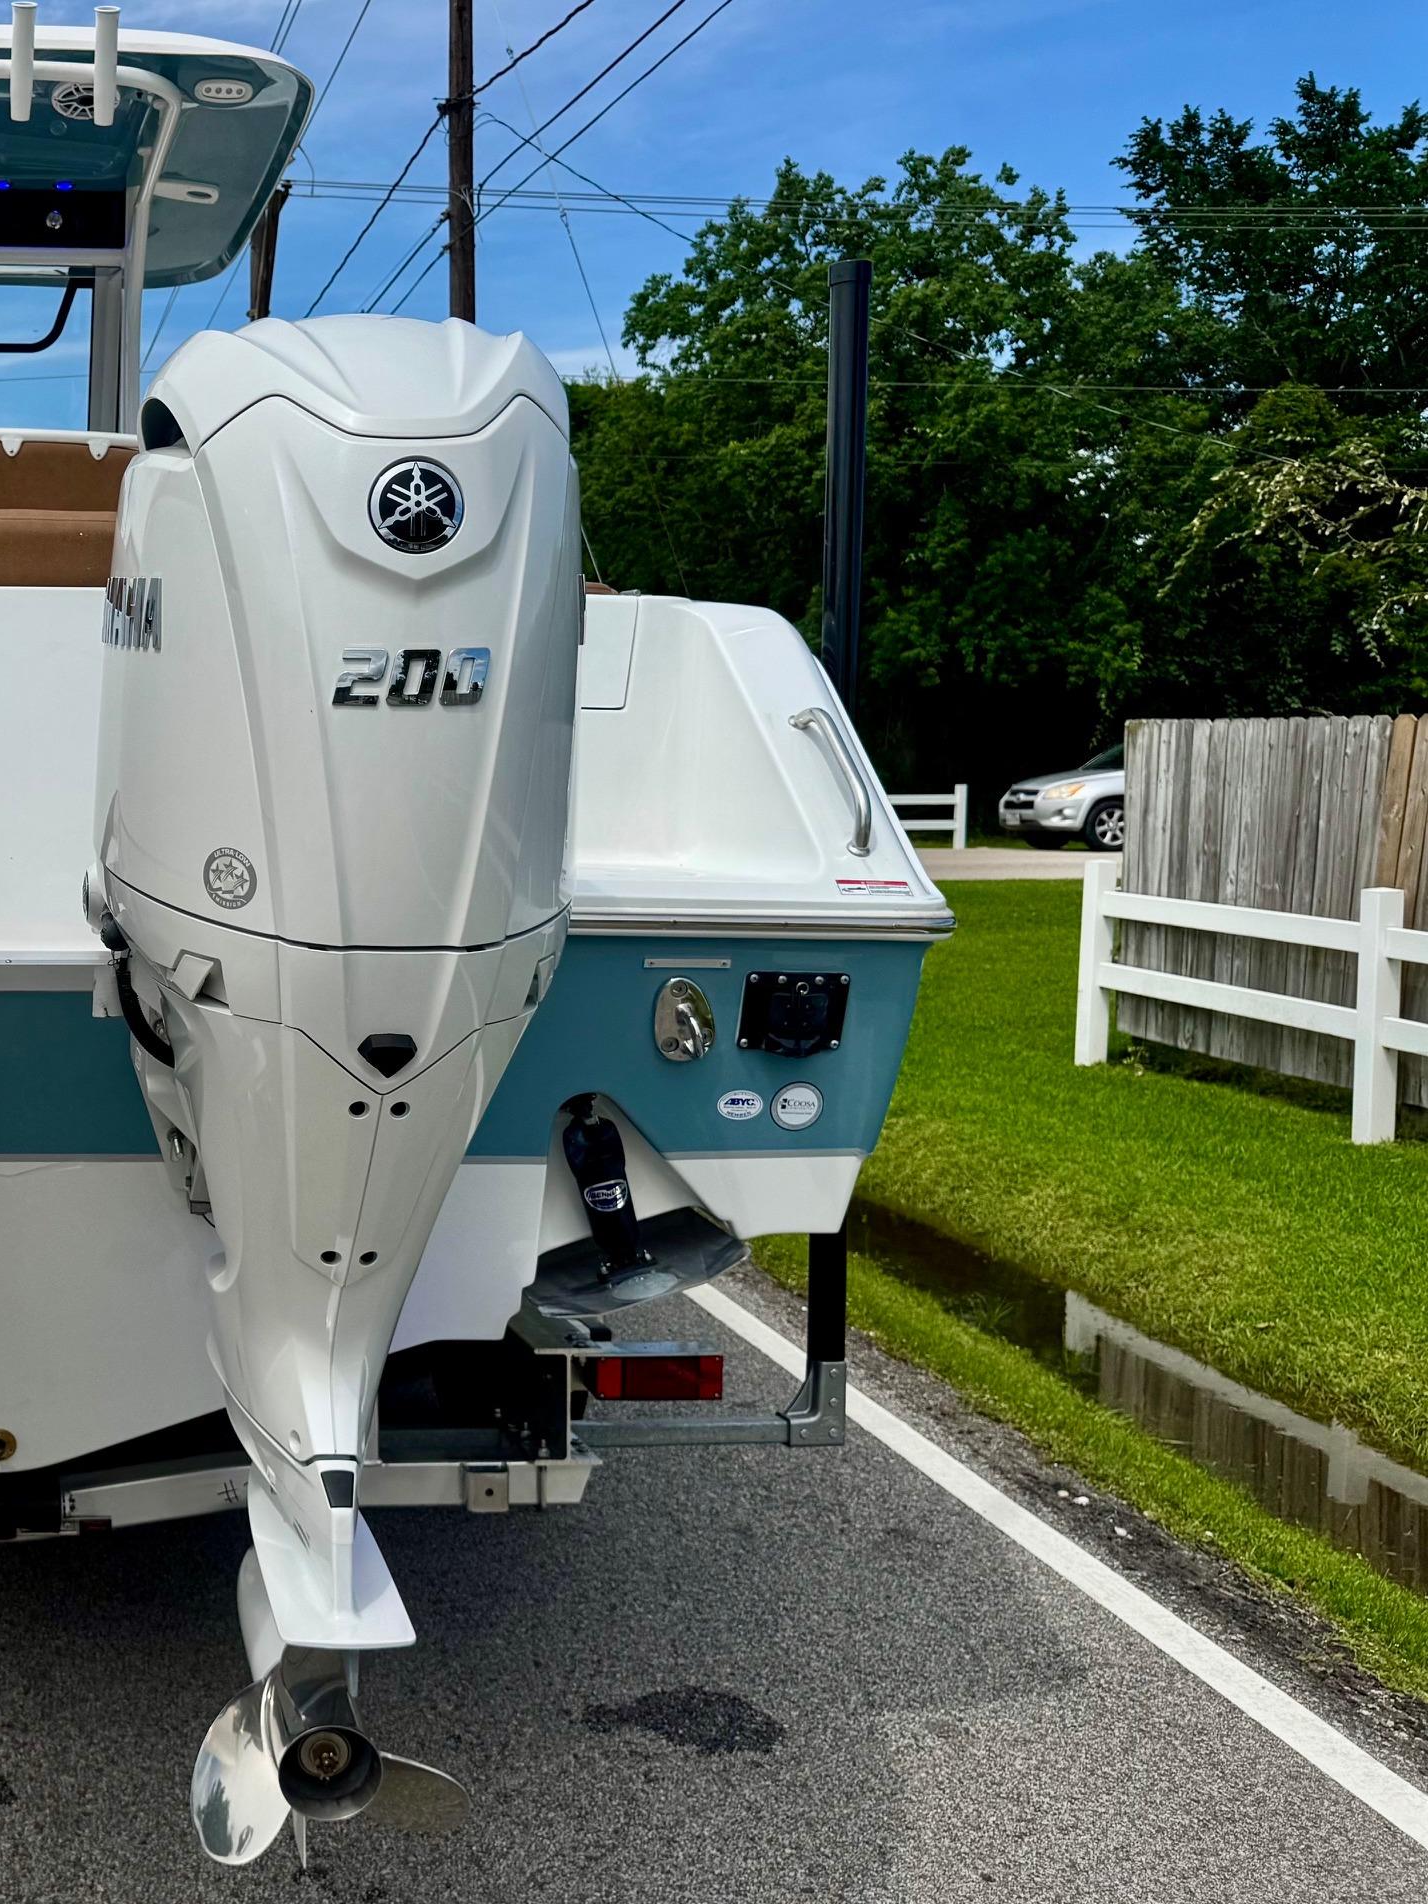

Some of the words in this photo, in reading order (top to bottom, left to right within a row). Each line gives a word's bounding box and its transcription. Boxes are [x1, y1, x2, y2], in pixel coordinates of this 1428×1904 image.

[332, 647, 492, 707] 200
[724, 1098, 756, 1106] ABYC
[787, 1099, 816, 1108] COOSA
